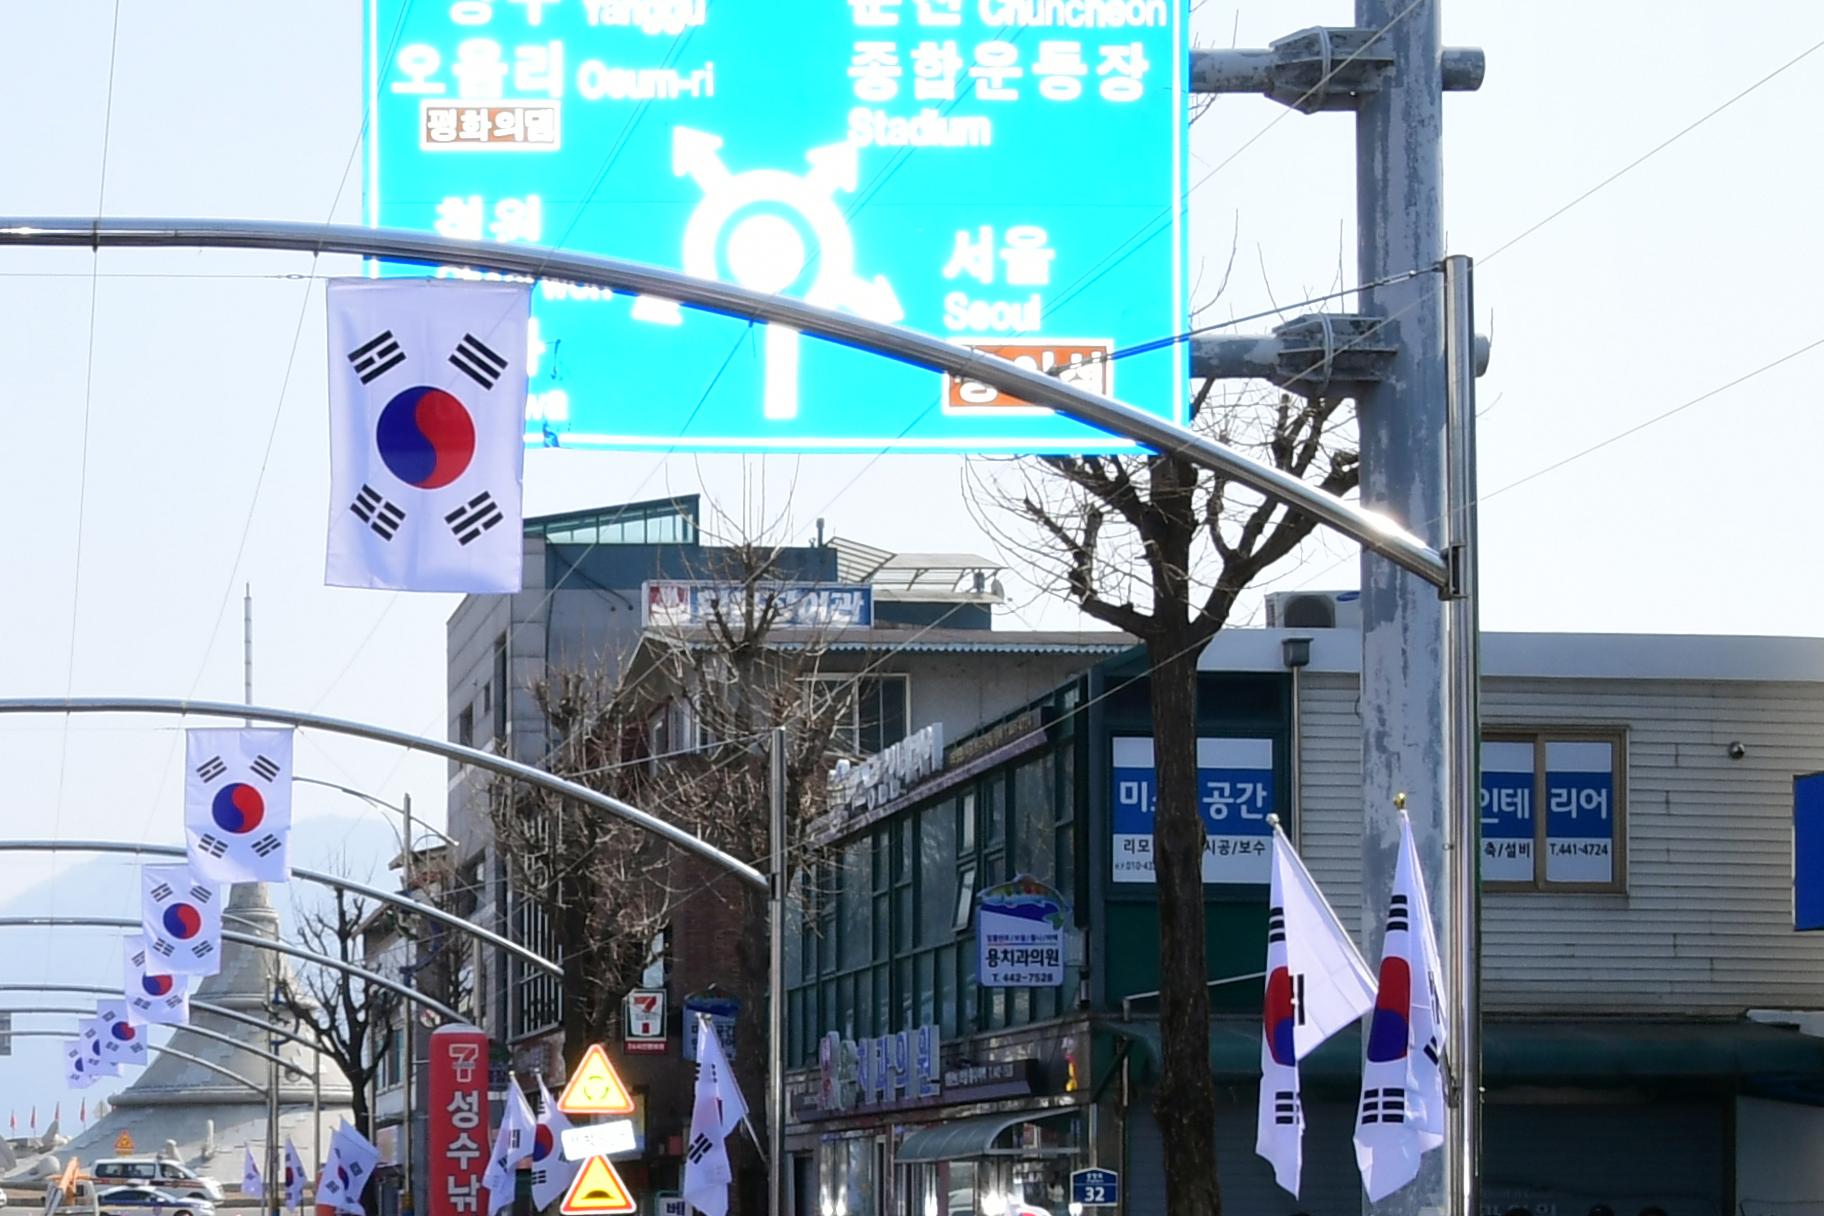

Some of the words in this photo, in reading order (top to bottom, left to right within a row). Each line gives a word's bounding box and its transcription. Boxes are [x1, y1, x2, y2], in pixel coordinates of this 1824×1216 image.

[847, 40, 1149, 101] 종합운동장
[847, 106, 991, 146] Stadium
[943, 225, 1055, 284] 서울
[944, 292, 1040, 330] Seoul
[986, 948, 1060, 968] 용치과의원
[1085, 1186, 1105, 1202] 32
